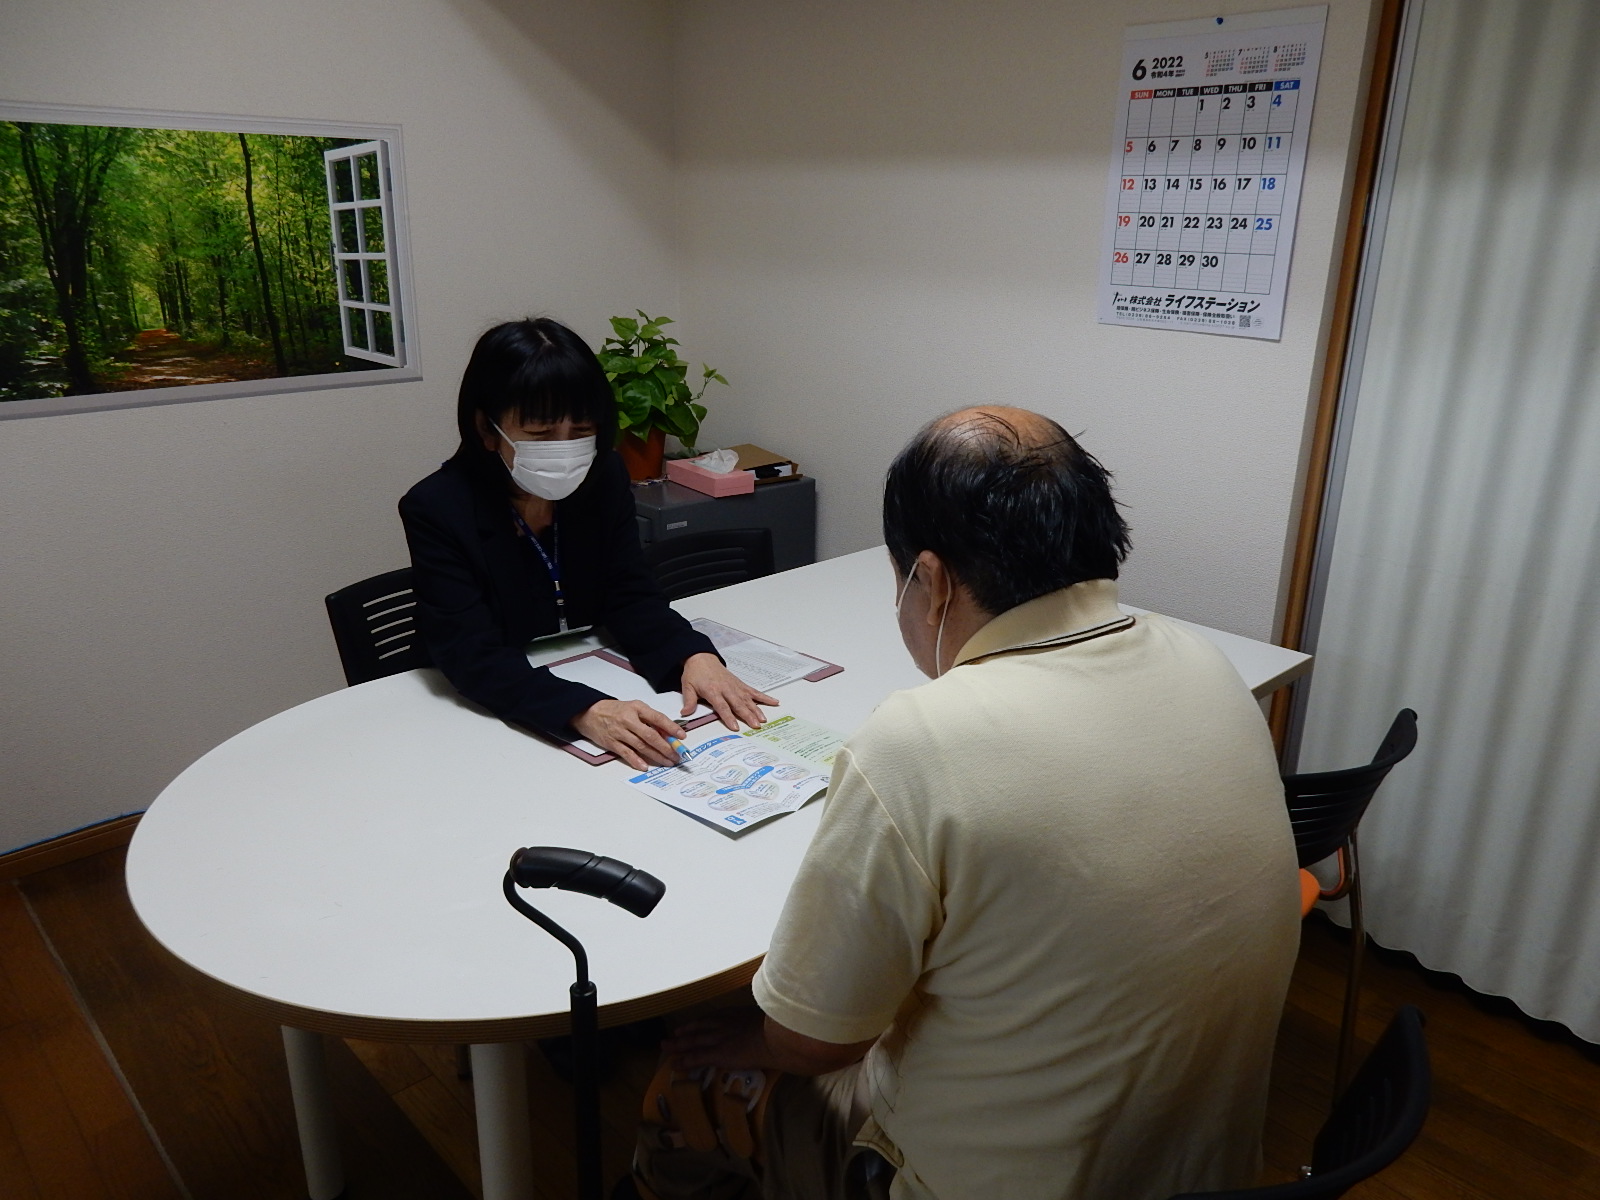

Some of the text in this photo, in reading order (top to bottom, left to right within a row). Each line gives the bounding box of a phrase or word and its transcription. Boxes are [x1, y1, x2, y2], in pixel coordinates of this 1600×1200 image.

[1132, 56, 1183, 81] 6 2022
[1150, 70, 1174, 79] 令和4年
[1156, 89, 1173, 97] MON
[1255, 83, 1266, 91] FRI
[1199, 95, 1282, 111] 1 2 3 4
[1126, 137, 1281, 152] 5 6 7 8 9 10 11
[1122, 178, 1276, 190] 12 13 14 15 16 17 18
[1118, 216, 1273, 231] 19 20 21 22 23 24 25
[1114, 252, 1218, 268] 26 27 28 29 30
[1129, 295, 1162, 307] 株式会社
[1165, 294, 1260, 313] ライフステーション
